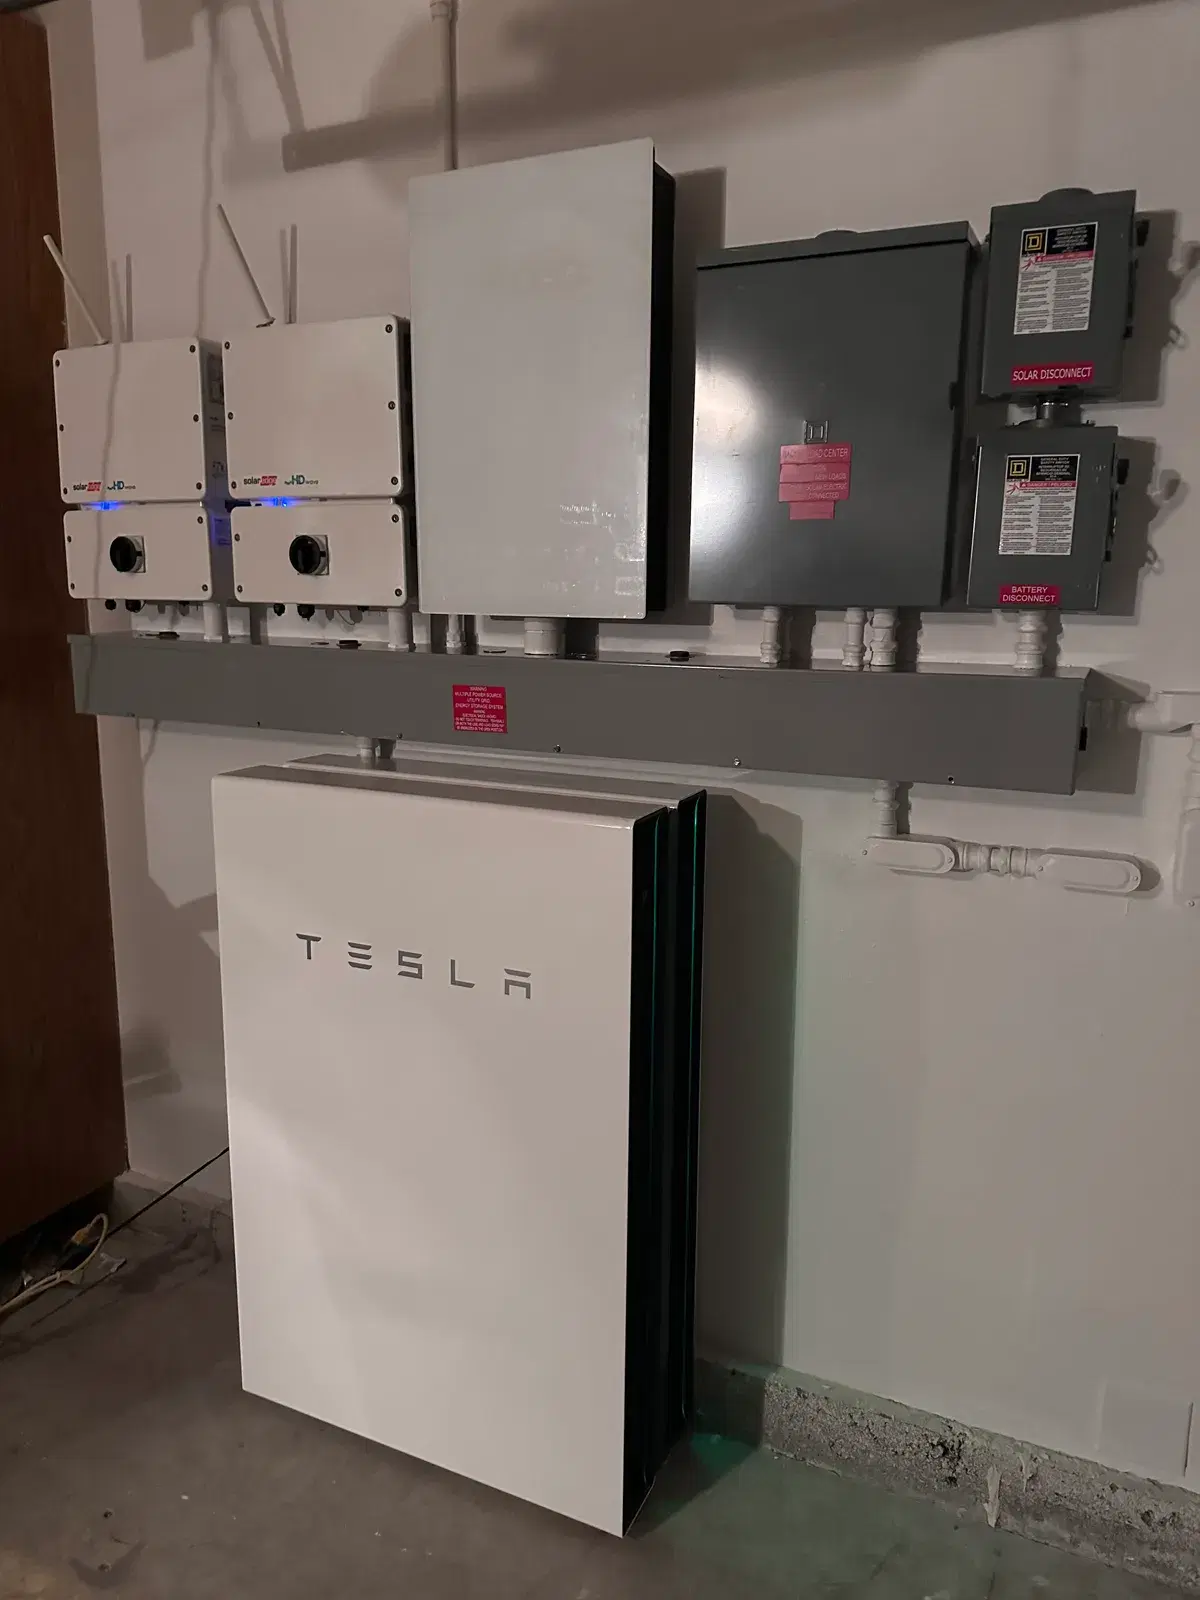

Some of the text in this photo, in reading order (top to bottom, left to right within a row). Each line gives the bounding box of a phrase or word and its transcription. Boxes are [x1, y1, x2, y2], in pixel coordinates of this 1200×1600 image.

[1012, 366, 1092, 381] SOLAR DISCONNECT
[824, 448, 848, 458] CENTER
[1002, 594, 1056, 602] DISCONNECT
[296, 933, 531, 999] TESLA
